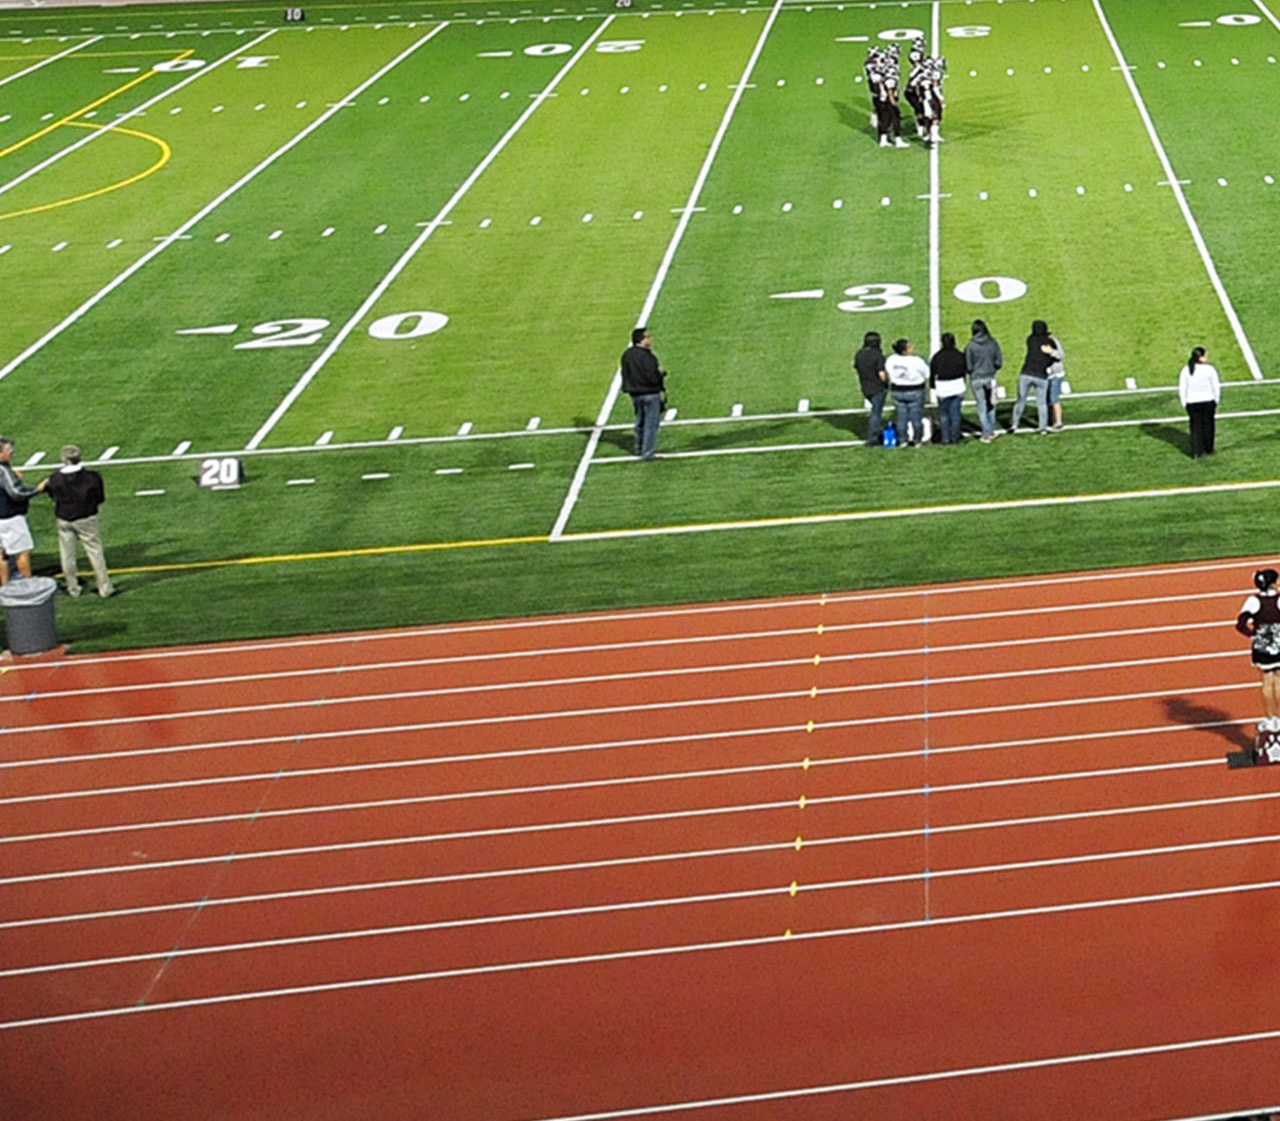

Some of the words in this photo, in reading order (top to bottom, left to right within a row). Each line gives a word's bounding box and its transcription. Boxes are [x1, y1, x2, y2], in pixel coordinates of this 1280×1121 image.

[286, 7, 302, 21] 10
[837, 276, 1027, 313] 30
[234, 310, 450, 350] 20
[200, 458, 239, 487] 20
